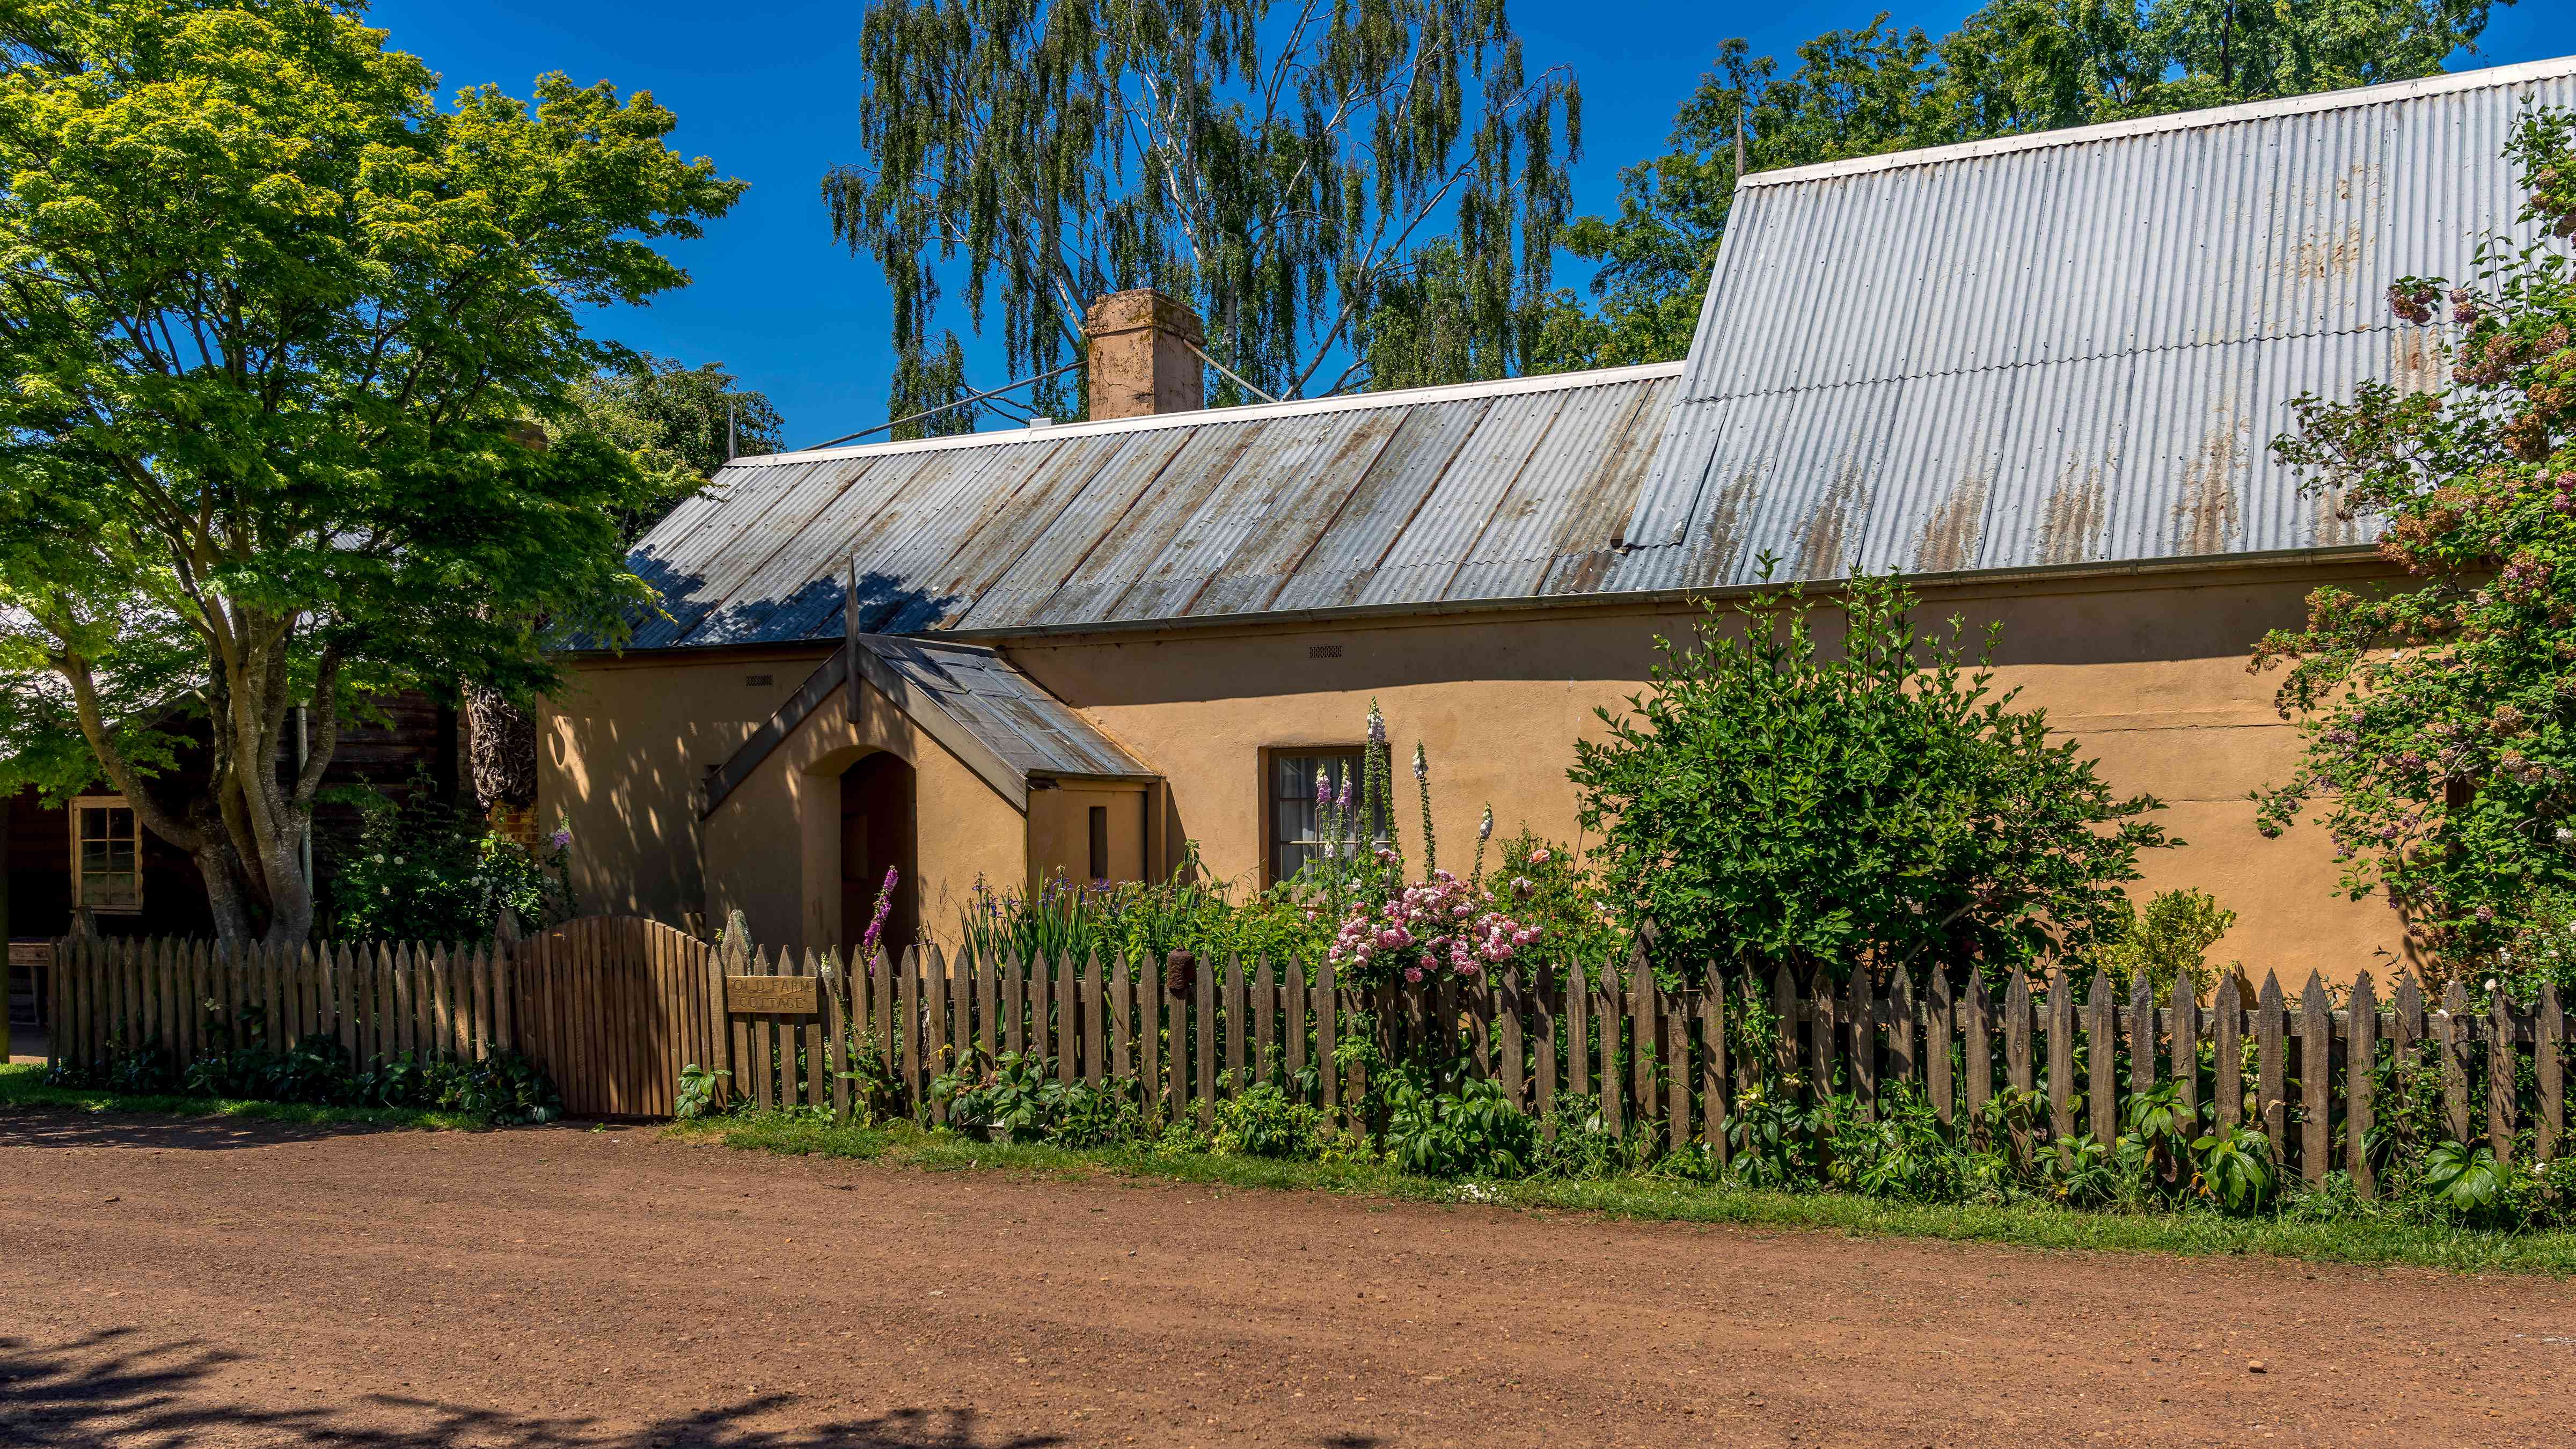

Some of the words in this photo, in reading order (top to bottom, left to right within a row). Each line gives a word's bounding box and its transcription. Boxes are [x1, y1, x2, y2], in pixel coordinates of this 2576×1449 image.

[734, 979, 765, 992] OLD
[772, 979, 809, 992] FARM
[739, 997, 804, 1008] COTTAGE
